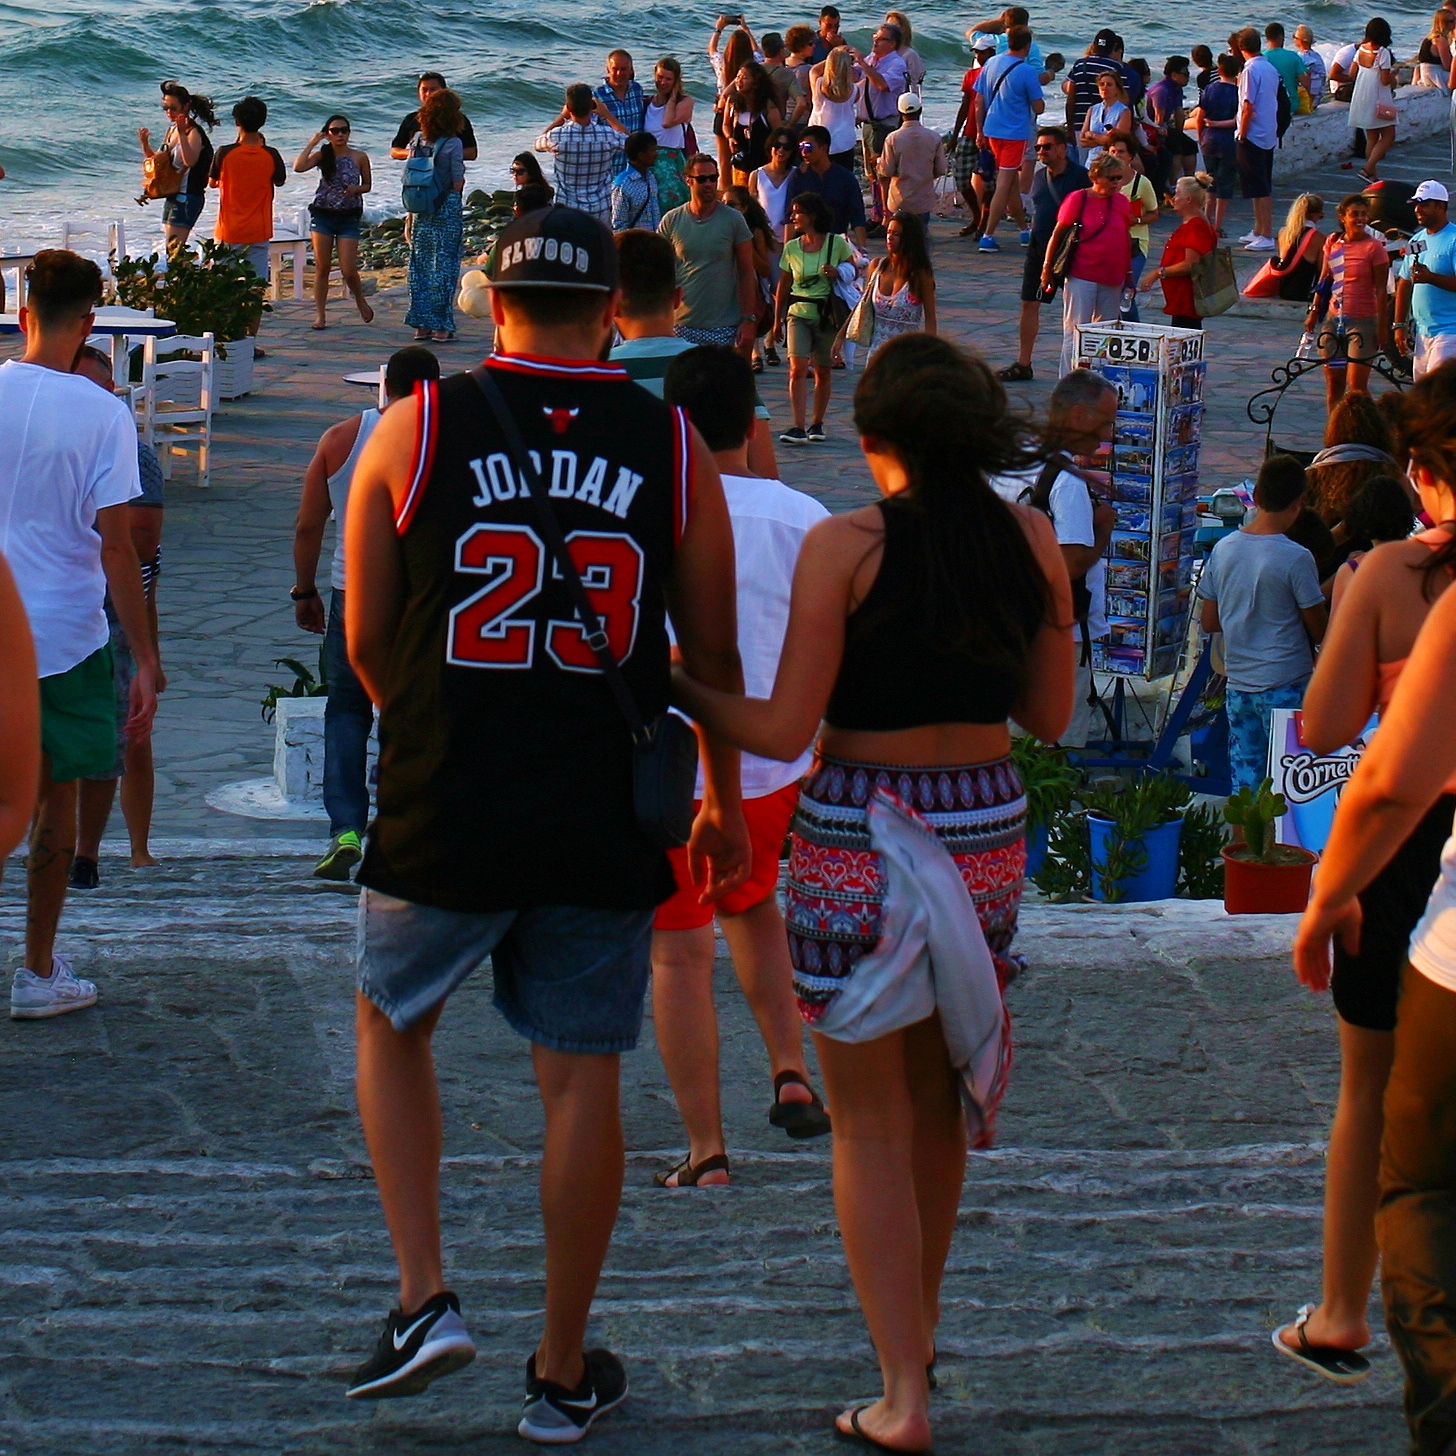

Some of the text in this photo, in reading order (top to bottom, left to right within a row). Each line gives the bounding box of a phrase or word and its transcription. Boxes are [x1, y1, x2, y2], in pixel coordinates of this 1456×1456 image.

[501, 236, 589, 273] ELWOOD
[446, 522, 644, 674] 23
[1280, 752, 1362, 804] Cornett
